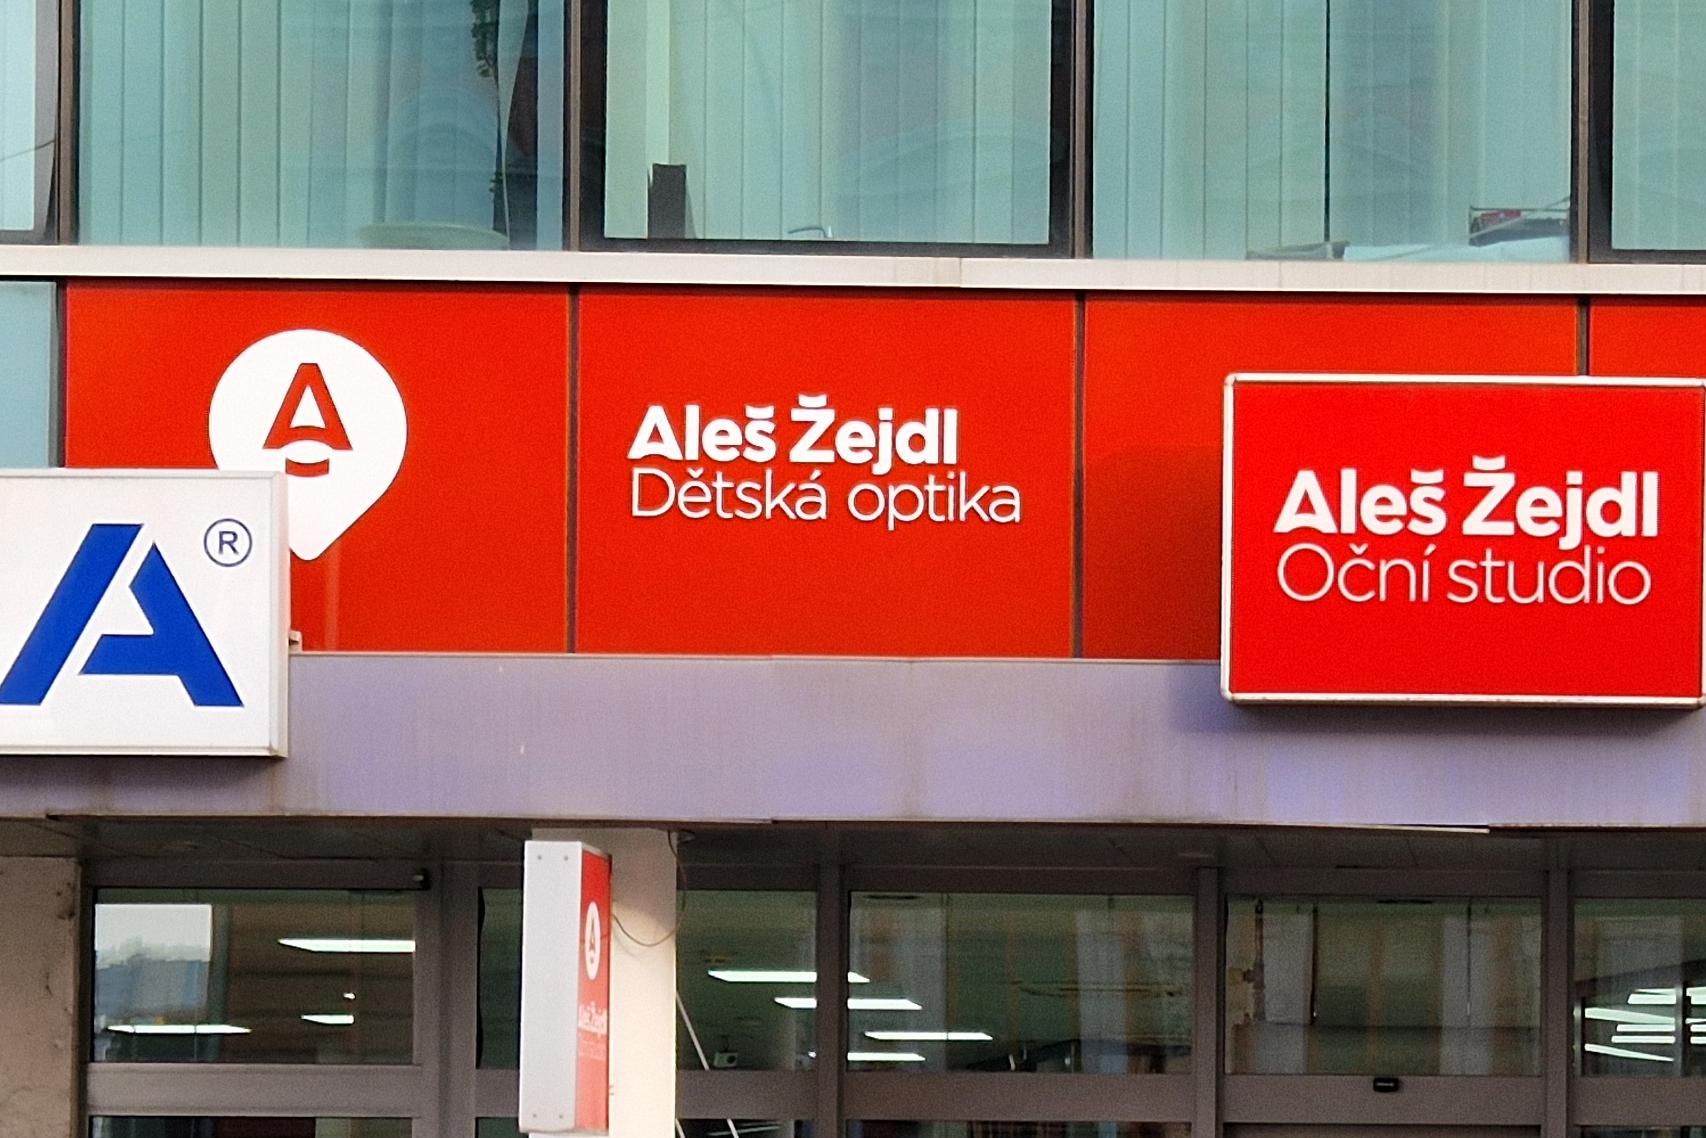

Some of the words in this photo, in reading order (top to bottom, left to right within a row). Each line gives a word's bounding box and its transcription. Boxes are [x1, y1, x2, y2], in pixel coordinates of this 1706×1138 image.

[627, 403, 777, 463] Aleš
[788, 393, 959, 476] Žejdl
[631, 466, 827, 521] Dětská
[847, 470, 1021, 531] optika
[1273, 467, 1448, 536] Aleš
[1462, 455, 1660, 550] Žejdl
[1277, 543, 1437, 602] Oční
[1447, 545, 1652, 605] studio
